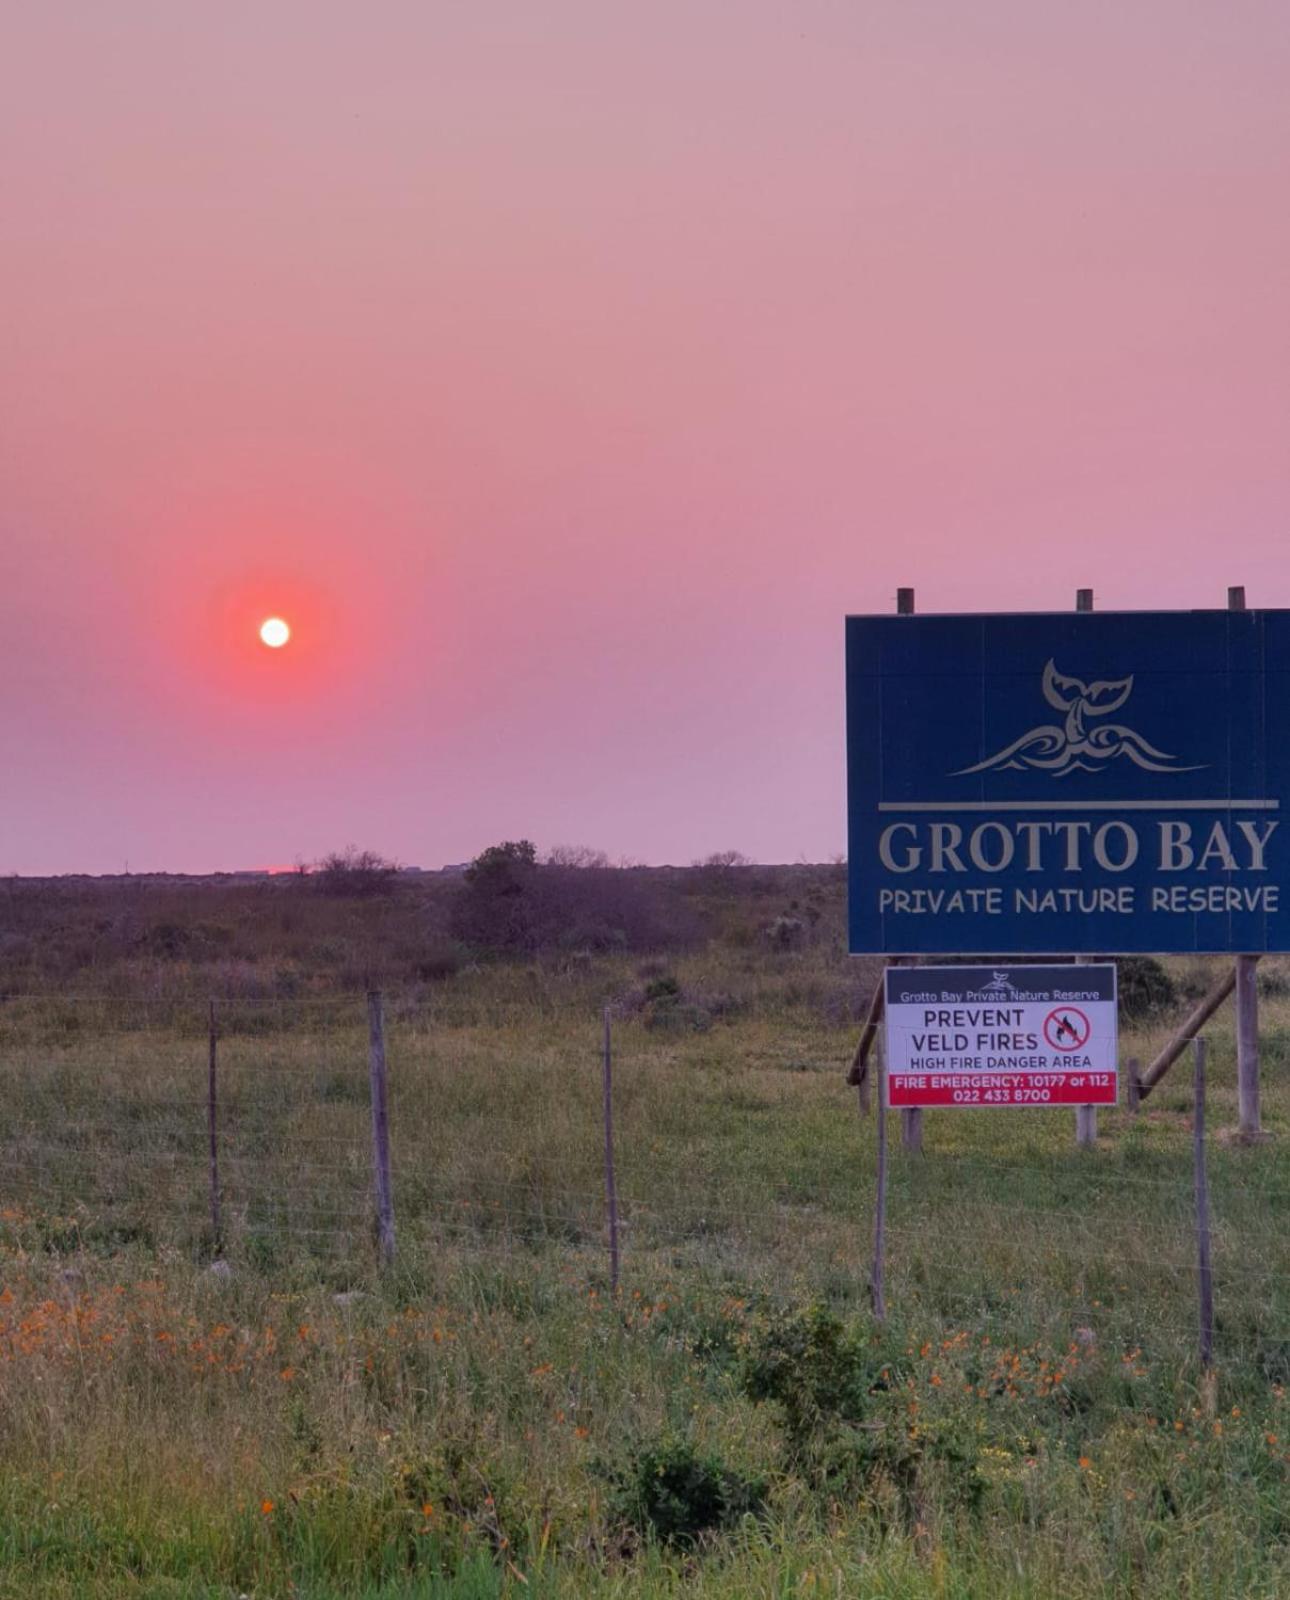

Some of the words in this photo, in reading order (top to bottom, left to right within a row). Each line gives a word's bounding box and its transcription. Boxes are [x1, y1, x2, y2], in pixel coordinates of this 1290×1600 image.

[878, 821, 1139, 873] GROTTO
[1156, 820, 1279, 871] BAY
[879, 888, 1002, 914] PRIVATE
[1016, 887, 1134, 912] NATURE
[1152, 886, 1279, 912] RESERVE
[900, 992, 937, 1002] Grotto
[942, 992, 961, 1003] Bay
[966, 991, 1007, 1001] Private
[1010, 991, 1049, 1000] Nature
[1053, 990, 1100, 1000] Reserve
[925, 1009, 1025, 1027] PREVENT
[912, 1035, 968, 1051] VELD
[977, 1033, 1038, 1050] FIRES
[911, 1058, 945, 1069] HIGH
[951, 1057, 982, 1068] FIRE
[987, 1056, 1047, 1068] DANGER
[1052, 1056, 1092, 1067] AREA
[895, 1077, 927, 1088] FIRE
[931, 1076, 1024, 1088] EMERGENCY:
[1028, 1075, 1066, 1086] 10177
[1070, 1077, 1085, 1086] or
[1089, 1075, 1109, 1086] 112
[953, 1091, 979, 1101] 022
[1014, 1089, 1050, 1100] 8700
